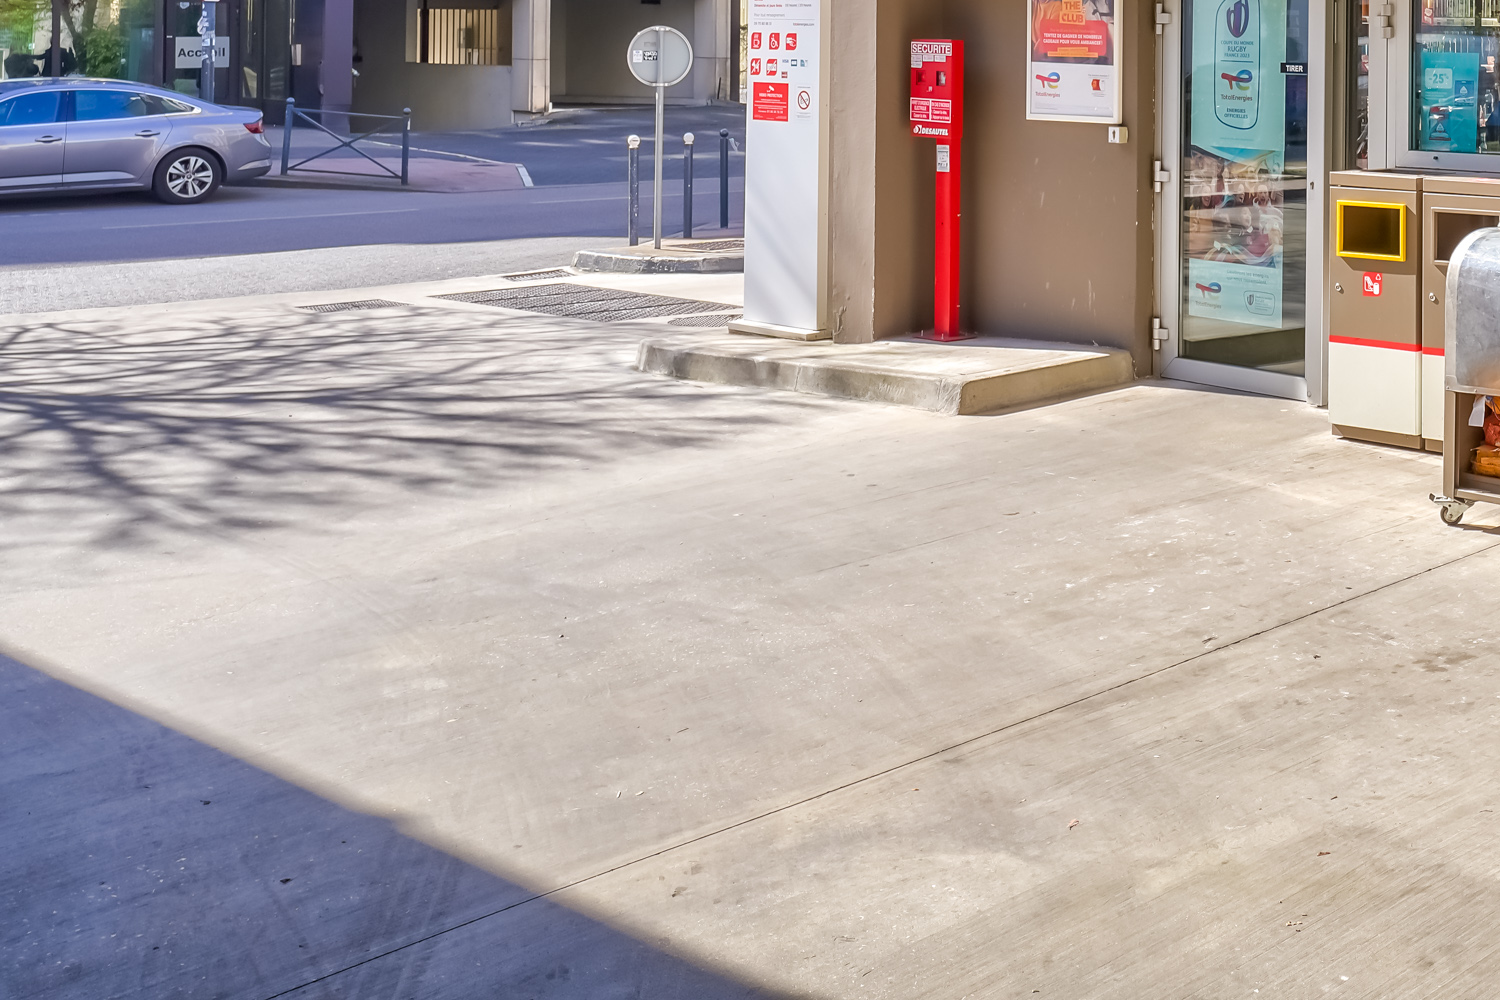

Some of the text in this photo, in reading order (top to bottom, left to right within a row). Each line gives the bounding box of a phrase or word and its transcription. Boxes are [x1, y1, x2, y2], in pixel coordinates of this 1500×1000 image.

[1063, 1, 1080, 10] THE
[1061, 13, 1083, 23] CLUB
[178, 47, 226, 58] Accil
[912, 43, 951, 54] SECURITE
[1285, 64, 1303, 72] TIRER
[1220, 93, 1252, 102] TotalEnergies
[921, 127, 948, 136] DESAUTEL
